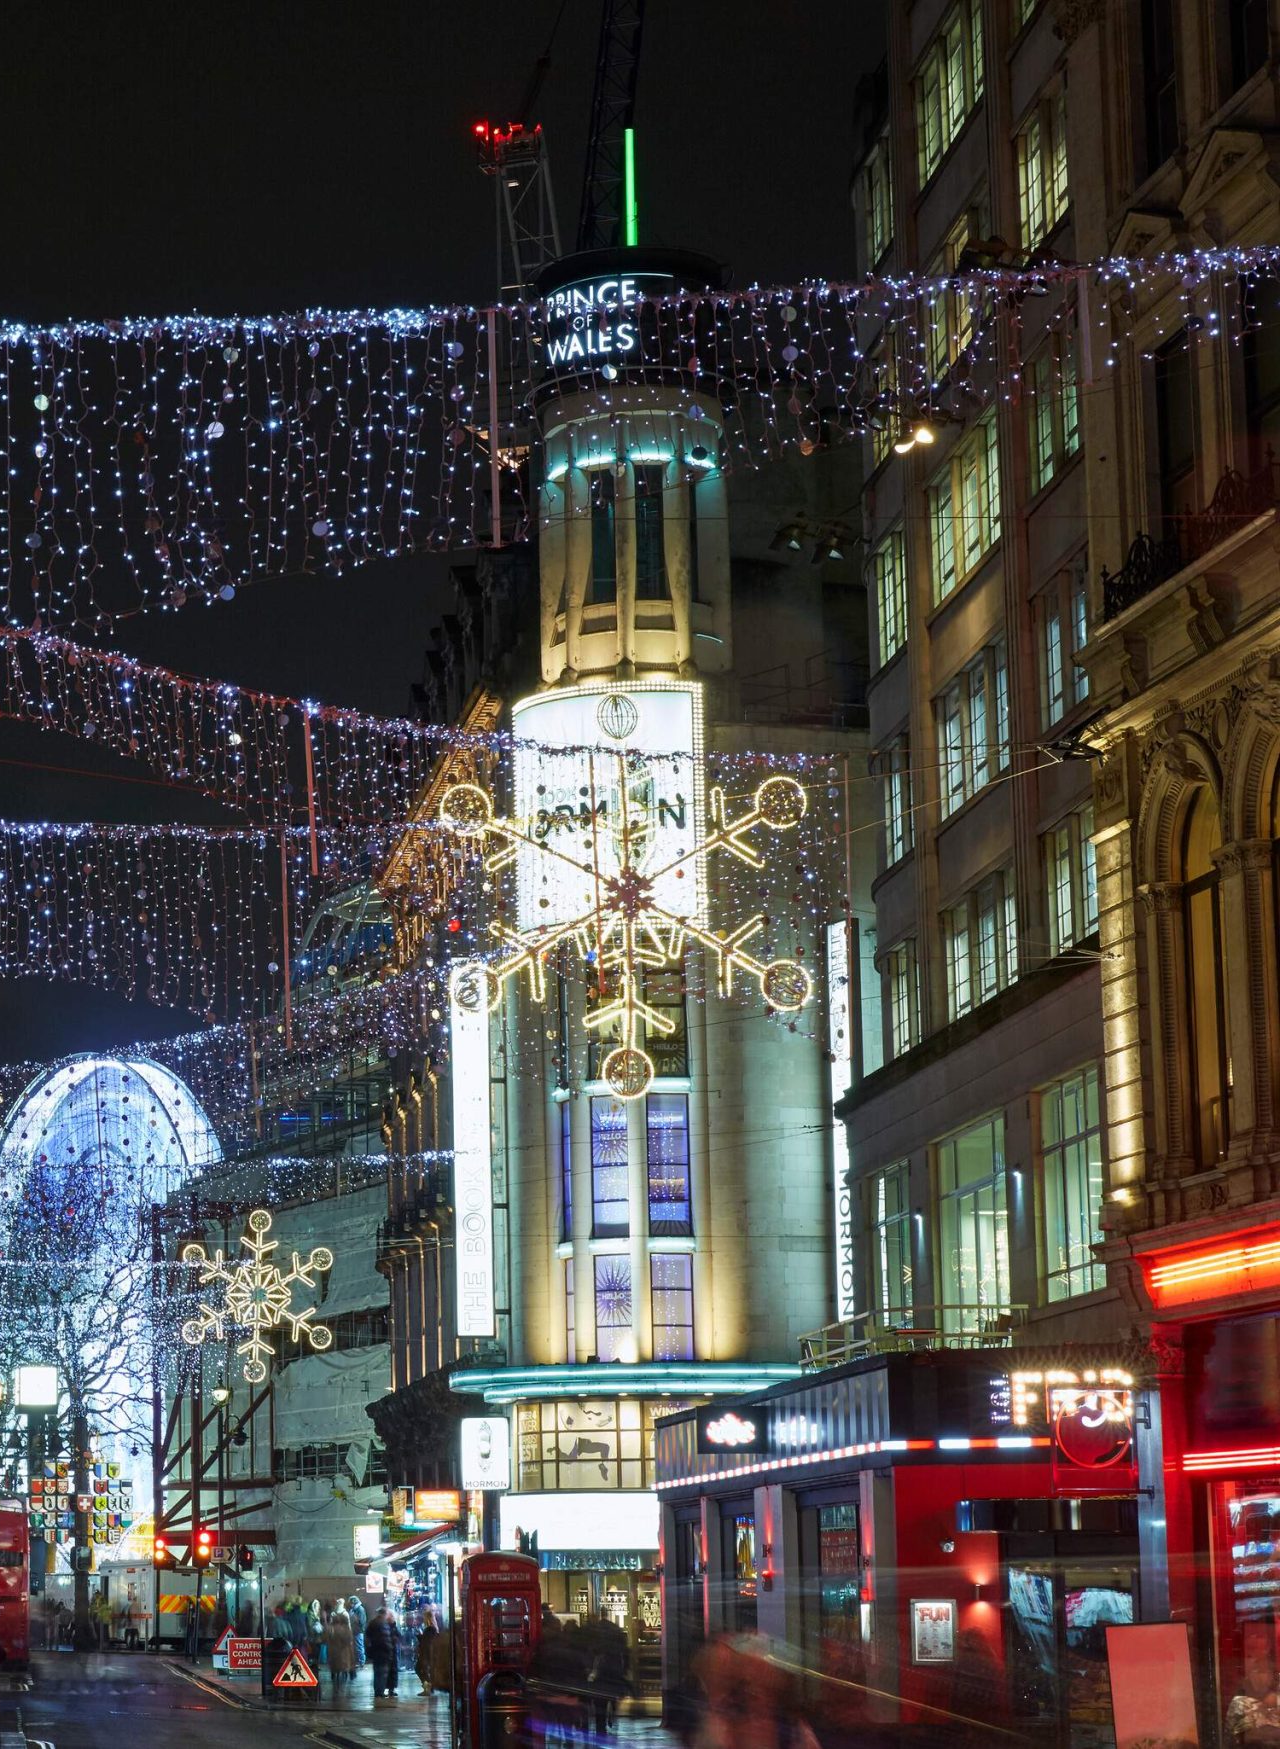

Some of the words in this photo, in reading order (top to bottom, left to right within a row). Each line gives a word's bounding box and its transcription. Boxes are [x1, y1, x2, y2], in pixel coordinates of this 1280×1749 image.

[546, 280, 636, 322] PRINCE
[547, 323, 635, 365] WALES
[572, 314, 593, 332] OF
[527, 796, 687, 841] ORMN
[461, 1168, 487, 1258] BOOK
[837, 1168, 854, 1317] MORMON
[461, 1271, 488, 1333] THE
[464, 1480, 508, 1489] MORMON
[918, 1607, 951, 1622] FUN
[232, 1650, 262, 1658] CONTRO
[234, 1642, 262, 1650] TRAFFI
